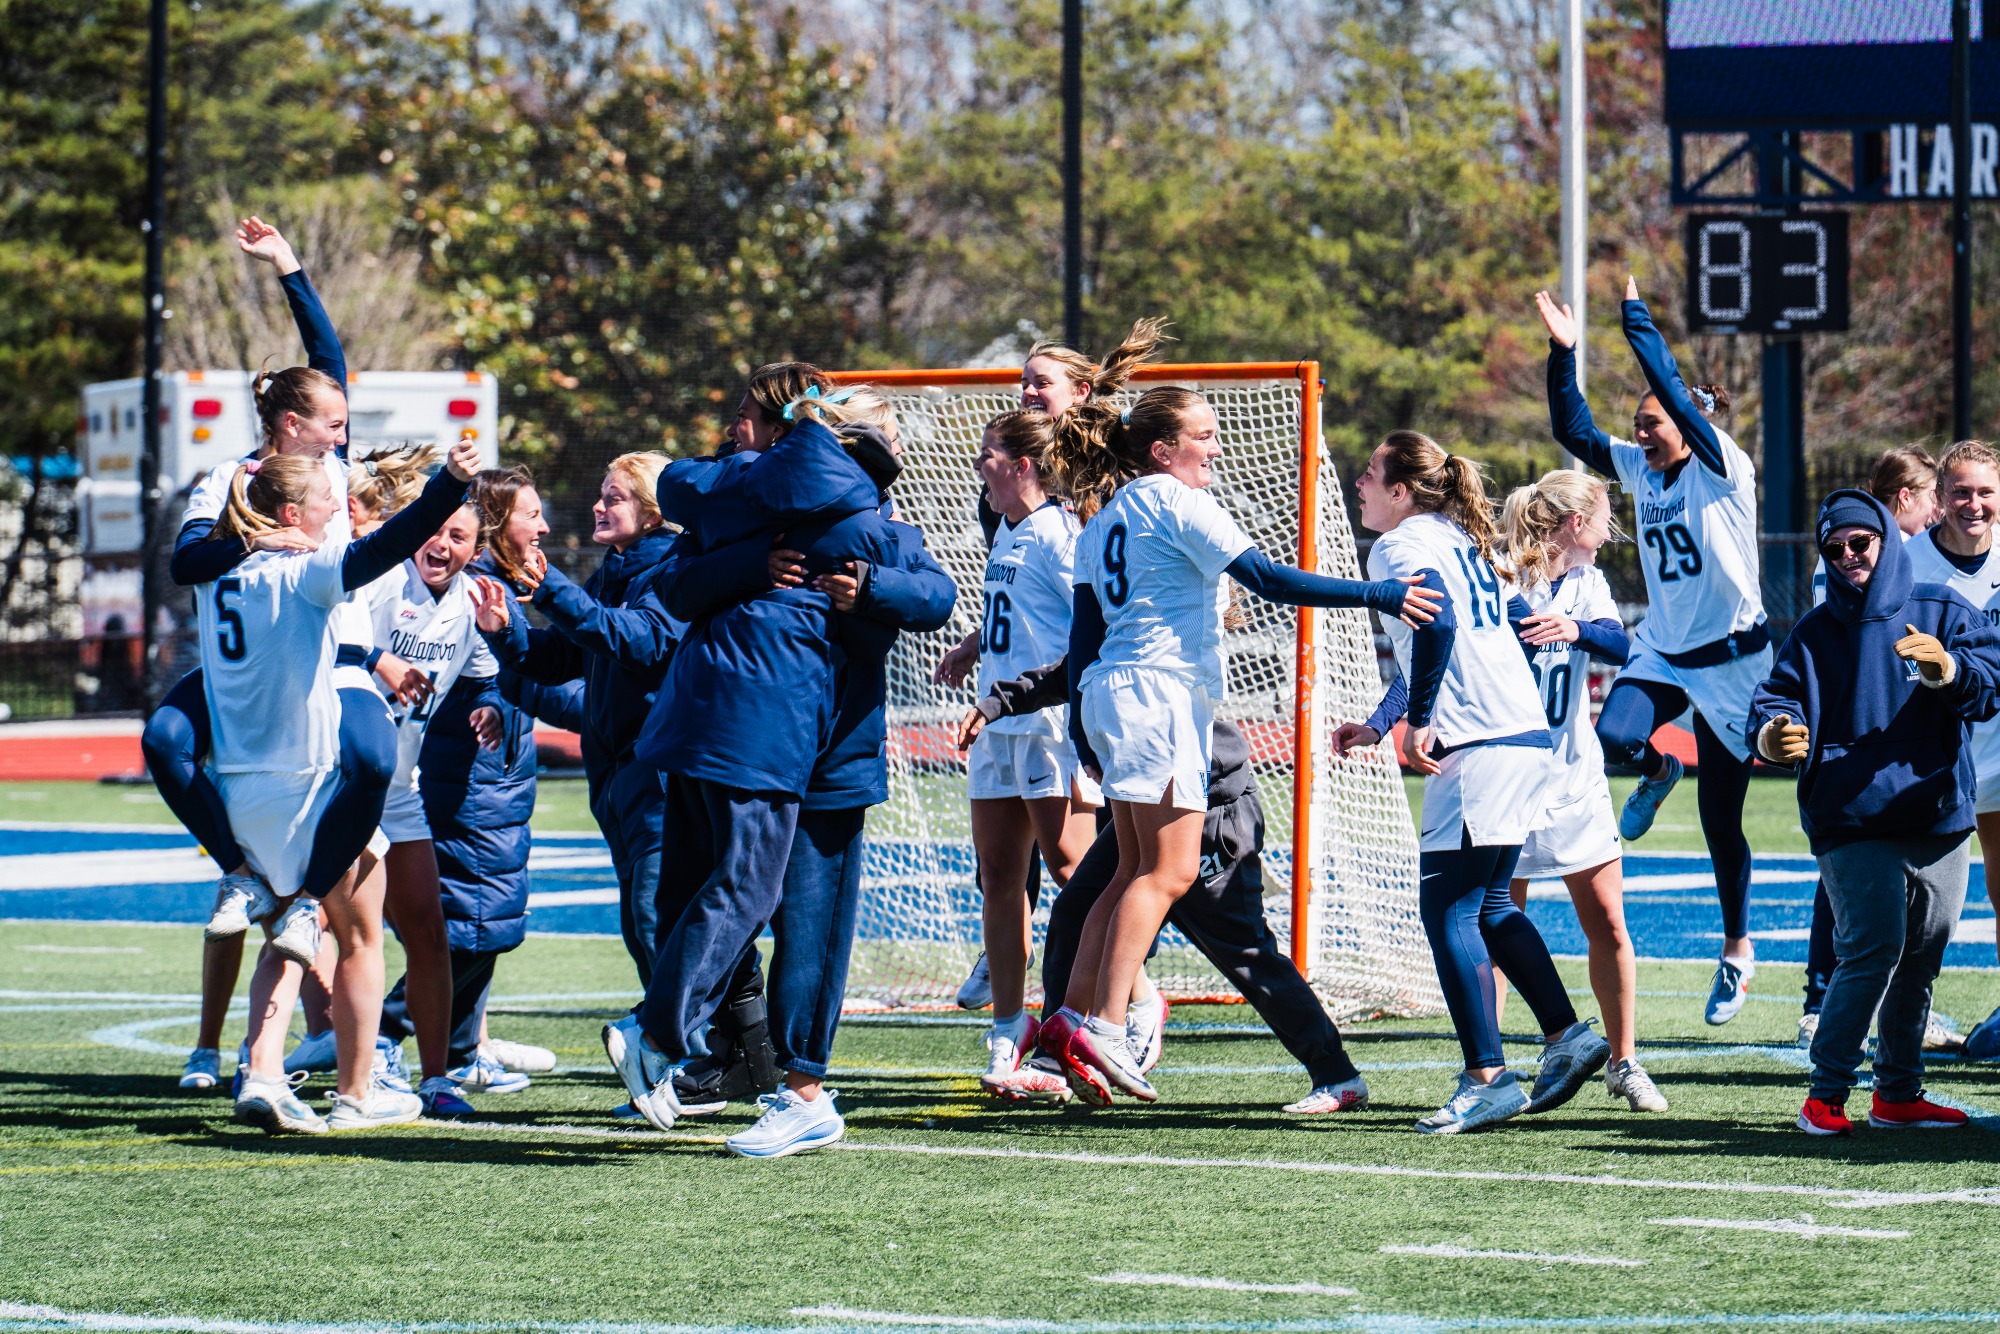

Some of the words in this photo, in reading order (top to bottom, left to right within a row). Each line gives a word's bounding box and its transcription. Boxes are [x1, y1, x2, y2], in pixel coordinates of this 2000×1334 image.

[1104, 521, 1128, 607] 9
[1453, 546, 1501, 630] 19
[1644, 523, 1702, 583] 29
[214, 576, 248, 662] 5
[1199, 851, 1224, 878] 21
